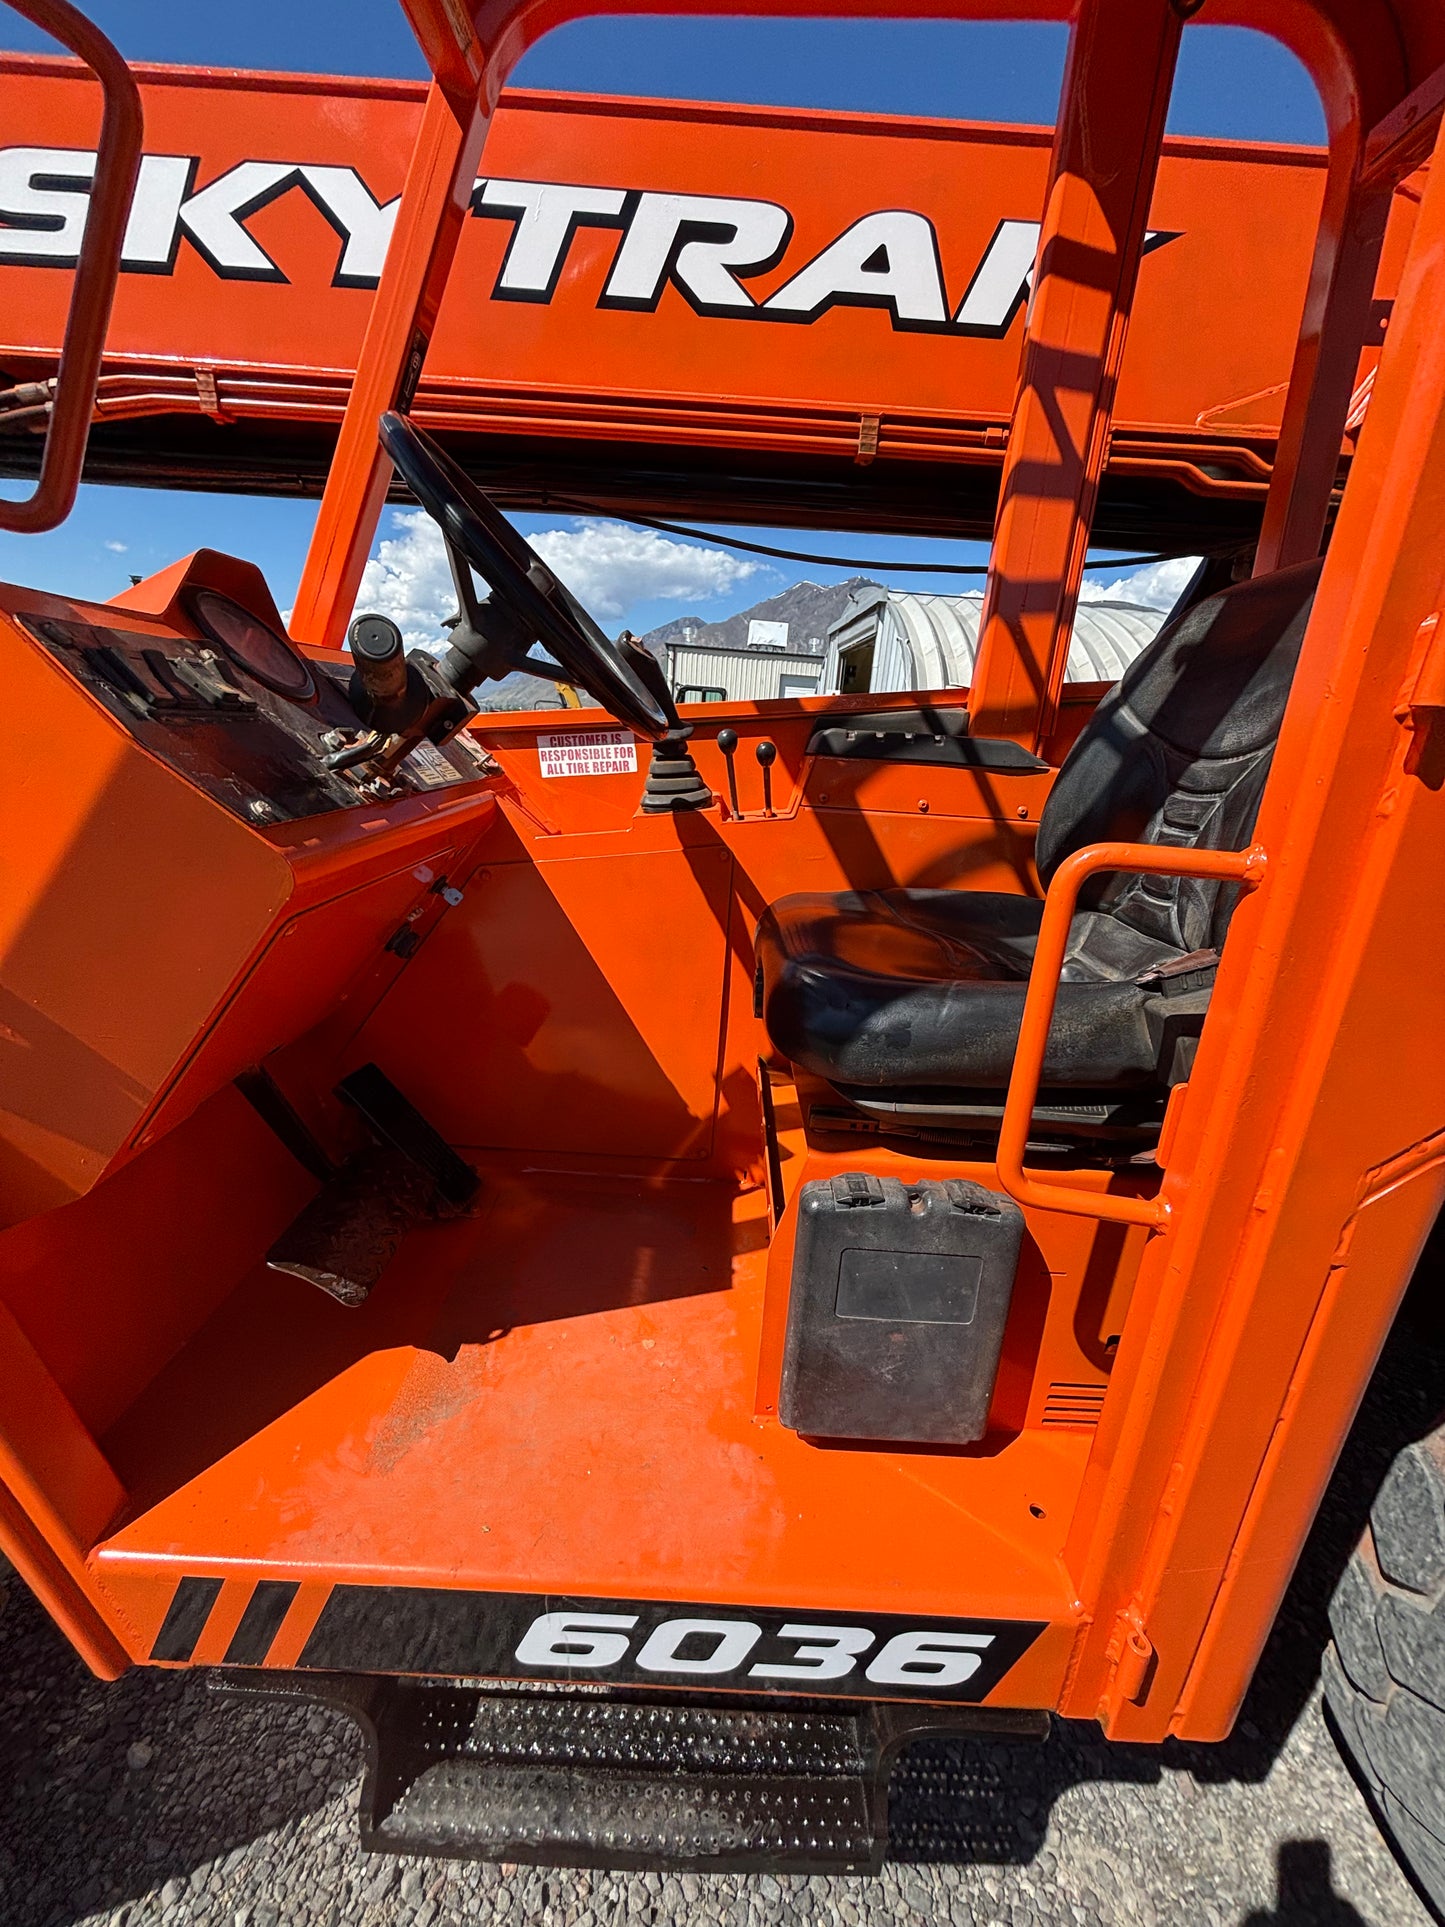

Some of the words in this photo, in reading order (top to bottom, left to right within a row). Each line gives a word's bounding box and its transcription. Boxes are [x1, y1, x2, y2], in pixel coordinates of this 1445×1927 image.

[549, 734, 608, 747] CUSTOMER
[611, 733, 622, 744] IS
[541, 748, 612, 762] RESPONSIBLE
[613, 746, 634, 759] FOR
[547, 763, 565, 775] ALL
[566, 762, 590, 774] TIRE
[592, 760, 630, 773] REPAIR
[515, 1612, 996, 1686] 6036
